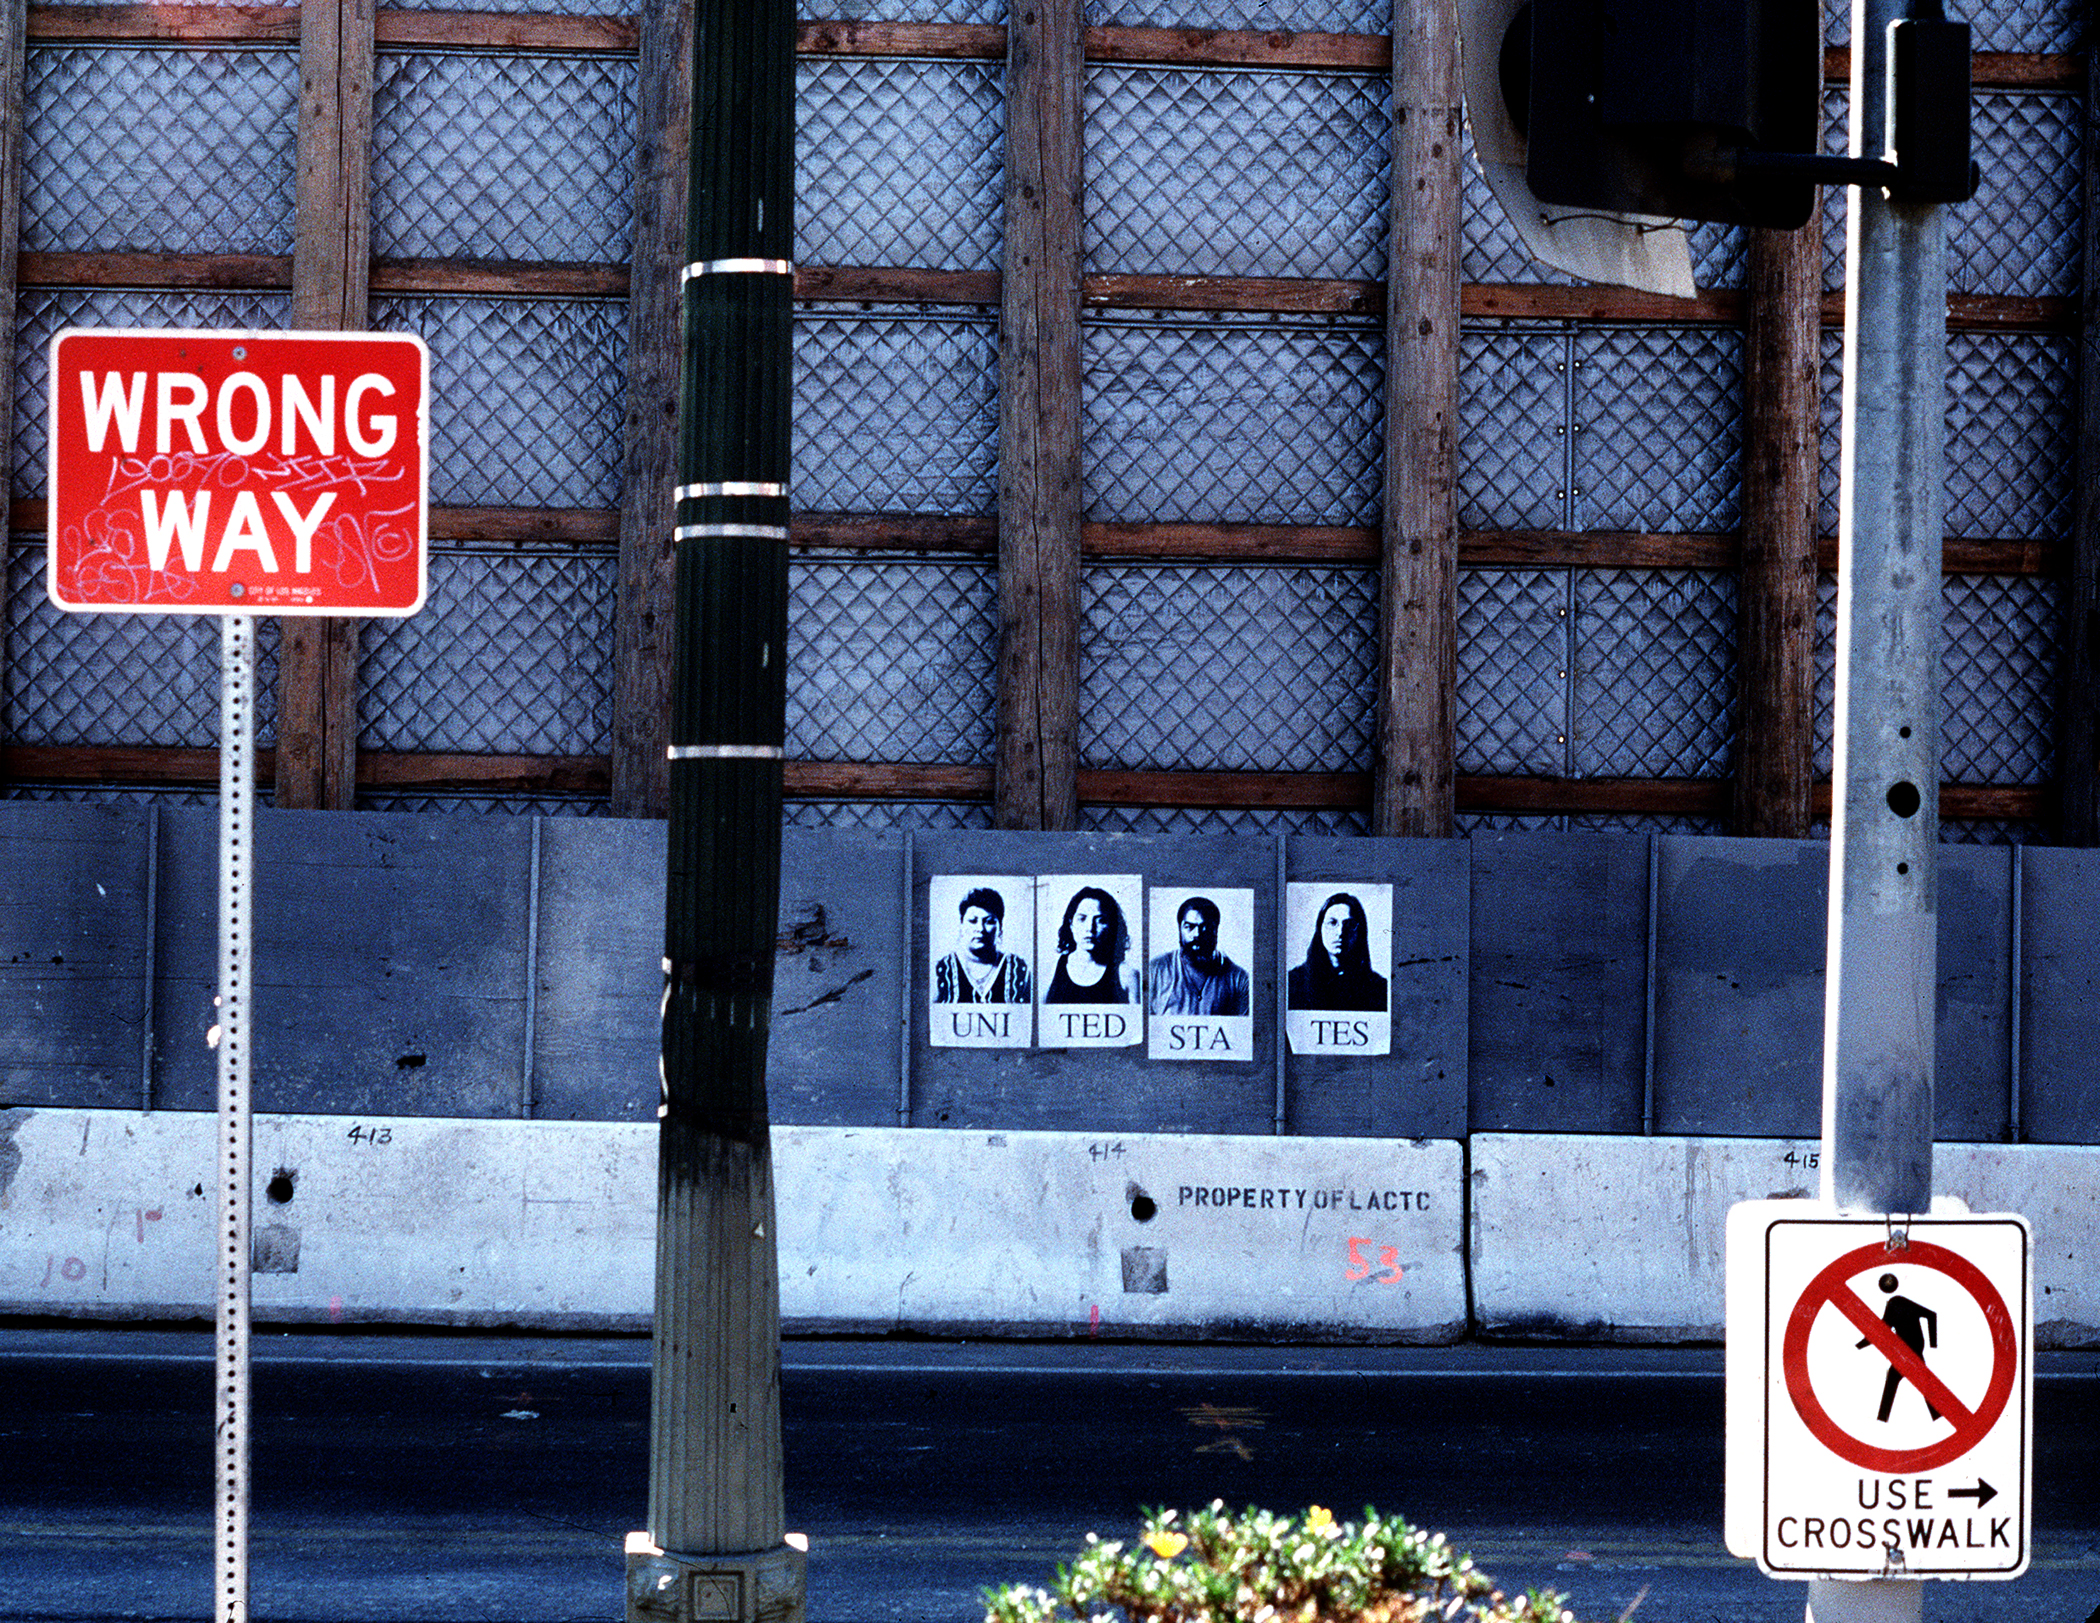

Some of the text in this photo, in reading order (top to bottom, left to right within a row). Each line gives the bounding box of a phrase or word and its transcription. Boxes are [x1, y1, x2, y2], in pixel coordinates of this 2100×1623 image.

[79, 370, 398, 458] WRONG
[140, 489, 338, 574] WAY
[951, 1012, 1011, 1038] UNI
[1059, 1013, 1126, 1038] TED
[1169, 1025, 1233, 1051] STA
[1311, 1020, 1369, 1046] TES
[347, 1125, 392, 1145] 413
[1088, 1142, 1126, 1162] 414
[1783, 1150, 1820, 1169] 415
[1178, 1186, 1430, 1211] PROPERTY OF LACTC
[1345, 1236, 1404, 1284] 53
[1858, 1479, 1933, 1509] USE
[1777, 1517, 2012, 1549] CROSSWALK
